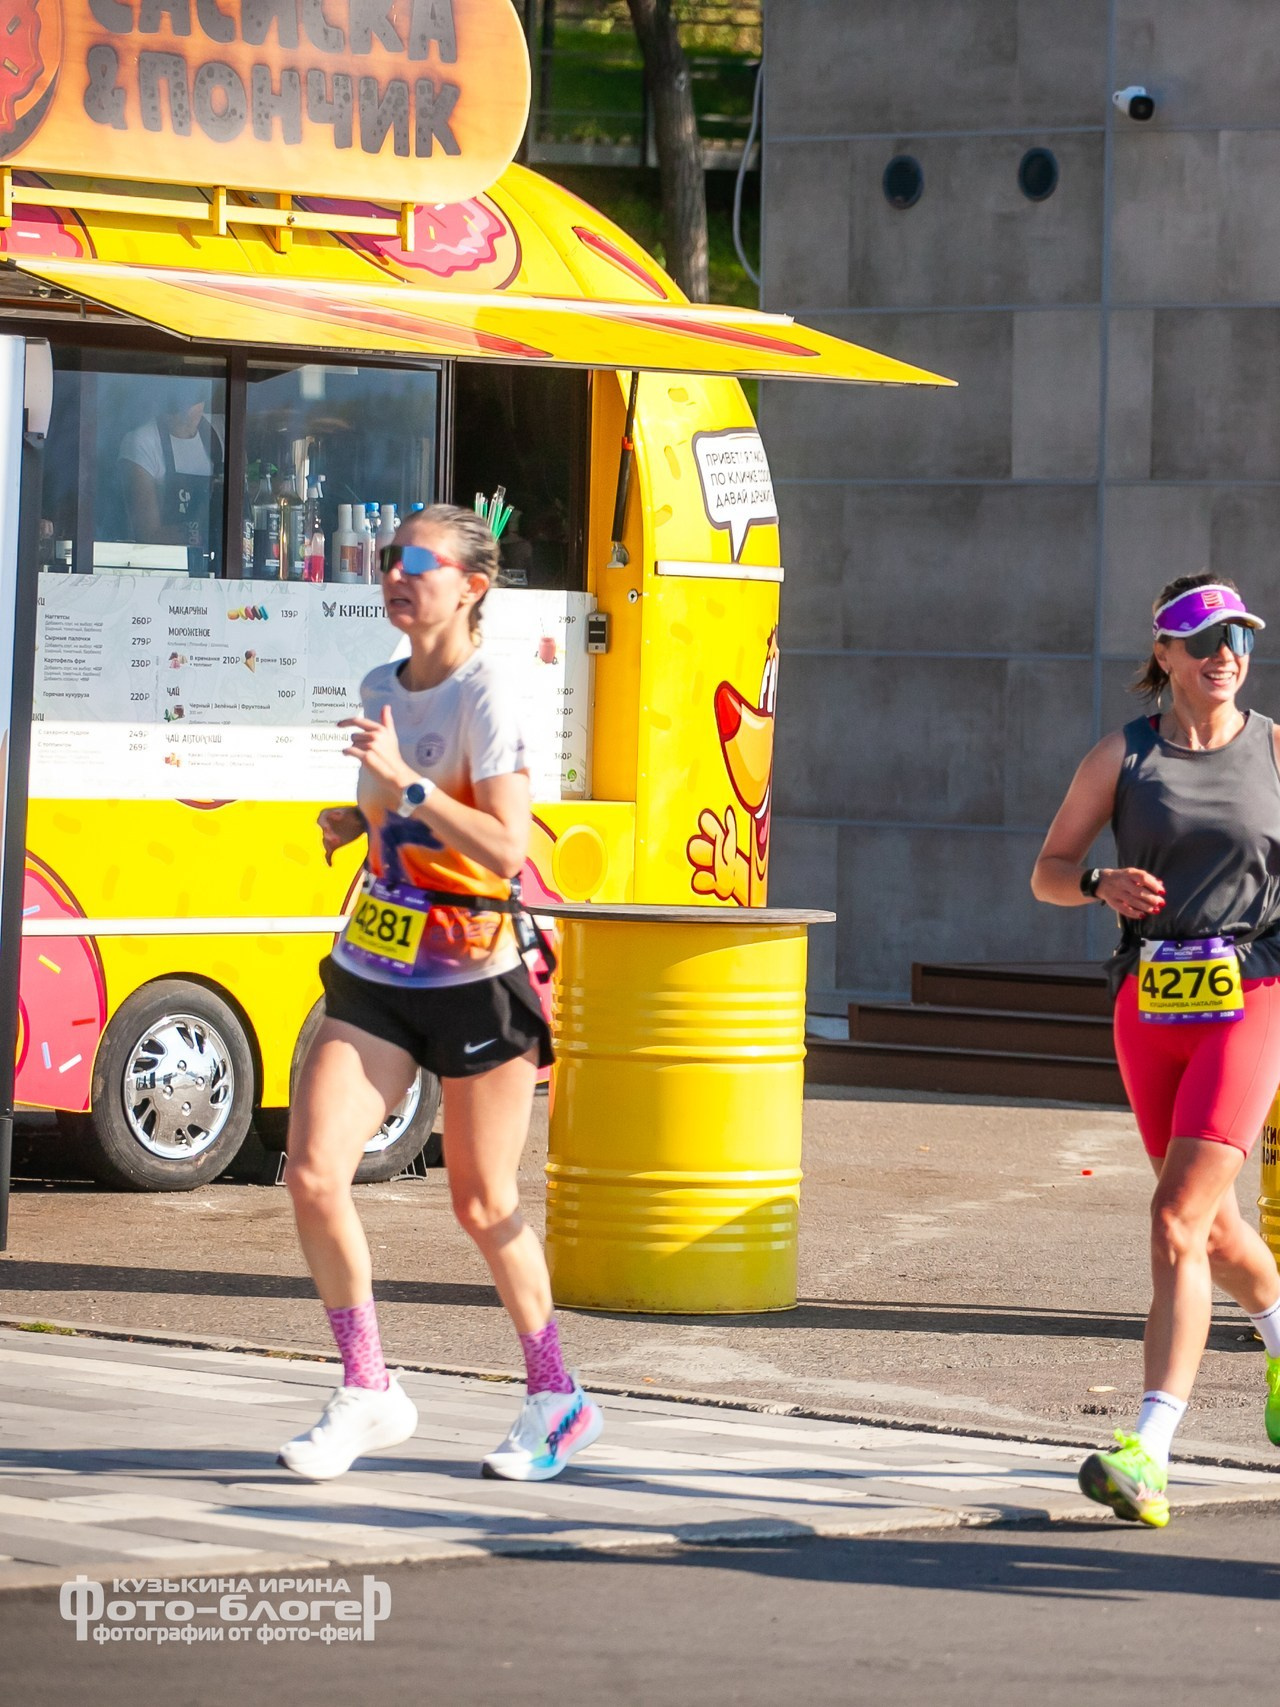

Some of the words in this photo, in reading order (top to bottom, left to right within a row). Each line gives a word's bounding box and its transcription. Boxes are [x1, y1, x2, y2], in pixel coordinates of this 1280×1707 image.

[710, 471, 726, 486] ПО
[716, 488, 748, 509] ДАВАЙ
[168, 605, 208, 616] МАКАРУНЫ
[168, 627, 211, 638] МОРОЖЕНОЕ
[43, 657, 73, 665] Картофель
[166, 686, 180, 697] ЧАЙ
[312, 685, 347, 697] ЛИМОНАД
[240, 703, 271, 711] Фруктовый
[311, 701, 346, 709] Тропический
[355, 900, 414, 948] 4281
[1141, 964, 1234, 999] 4276
